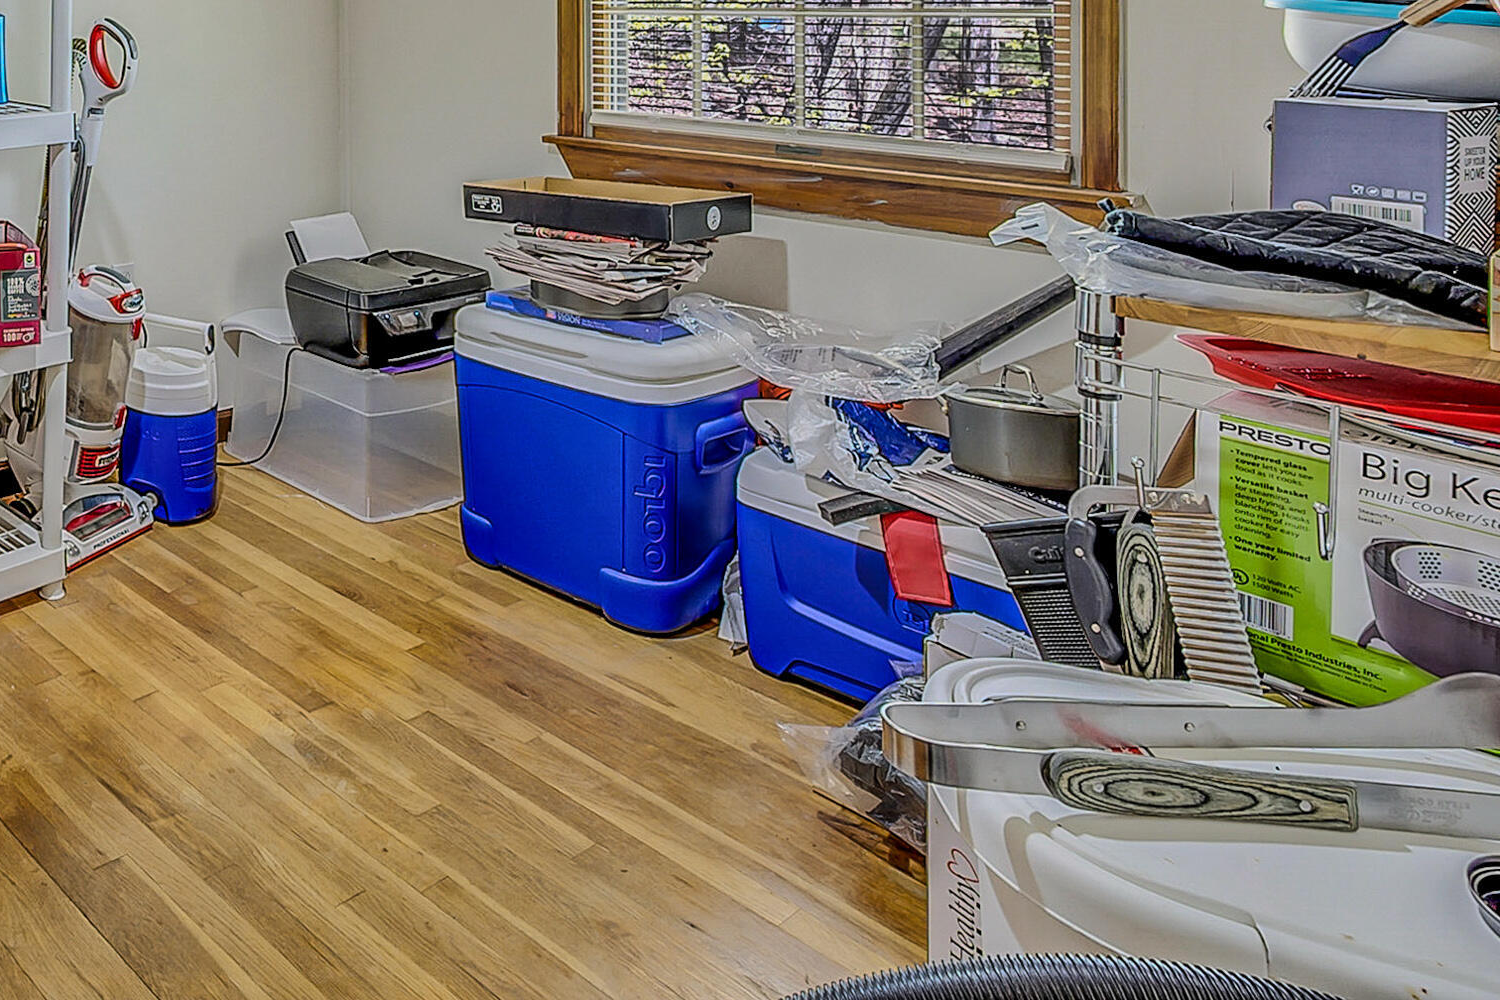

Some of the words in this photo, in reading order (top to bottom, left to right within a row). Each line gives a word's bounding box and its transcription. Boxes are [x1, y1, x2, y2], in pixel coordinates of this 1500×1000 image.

[1463, 167, 1485, 181] HOME
[1219, 421, 1331, 456] PRESTO
[1235, 448, 1281, 465] Tempered
[1283, 461, 1307, 472] glass
[1235, 458, 1260, 468] cover
[1262, 462, 1277, 472] lets
[1280, 468, 1296, 478] you
[1298, 473, 1314, 481] see
[1235, 464, 1255, 475] food
[1235, 475, 1275, 491] Versatile
[1276, 486, 1309, 500] basket
[1235, 483, 1247, 492] for
[1362, 452, 1431, 499] Big
[1451, 472, 1500, 511] Ke
[1235, 492, 1258, 503] deep
[1288, 506, 1307, 515] and
[1234, 508, 1256, 518] onto
[1257, 514, 1273, 523] rim
[1234, 516, 1264, 528] cooker
[1265, 523, 1278, 532] for
[1280, 528, 1300, 539] easy
[1234, 535, 1253, 546] One
[1255, 541, 1276, 552] year
[1276, 546, 1311, 562] limited
[1234, 543, 1279, 561] warranty.
[1252, 581, 1271, 592] 1500
[1271, 586, 1294, 599] Watts
[1267, 577, 1287, 589] Volts
[1270, 636, 1303, 654] Presto
[1304, 648, 1361, 674] Industries,
[1362, 668, 1383, 681] Inc.
[948, 876, 981, 961] Healthy
